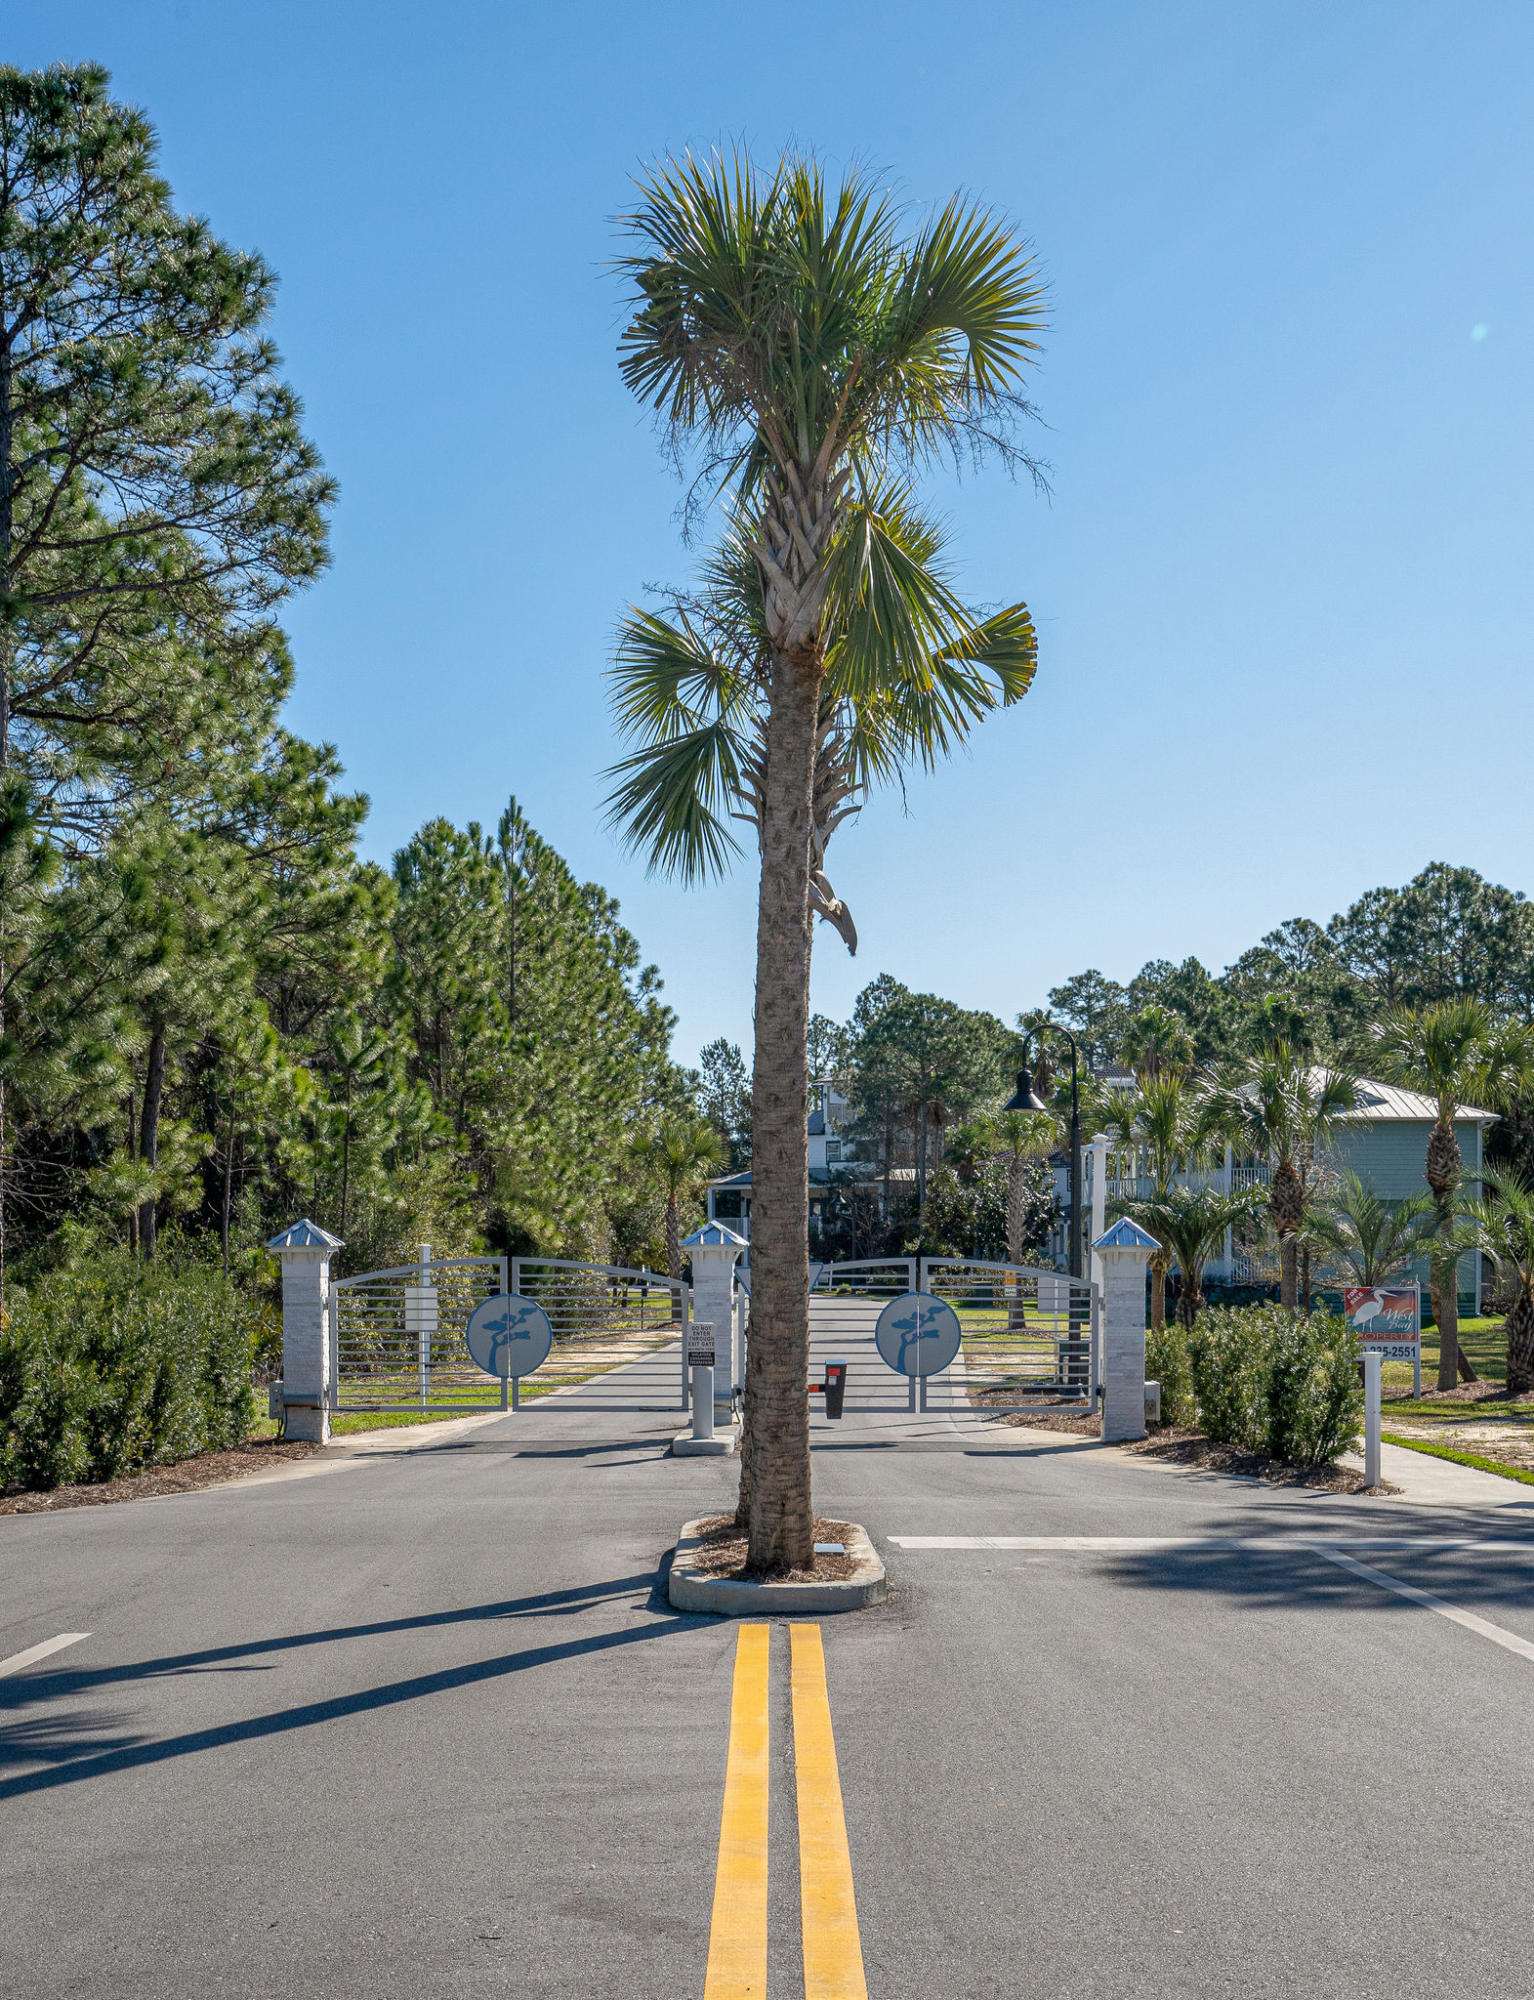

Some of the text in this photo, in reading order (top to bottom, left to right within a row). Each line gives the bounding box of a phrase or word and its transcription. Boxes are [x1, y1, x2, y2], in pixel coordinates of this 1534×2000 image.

[1383, 1307, 1414, 1321] West
[1388, 1319, 1412, 1331] Bay
[1356, 1332, 1414, 1340] ROPERTY
